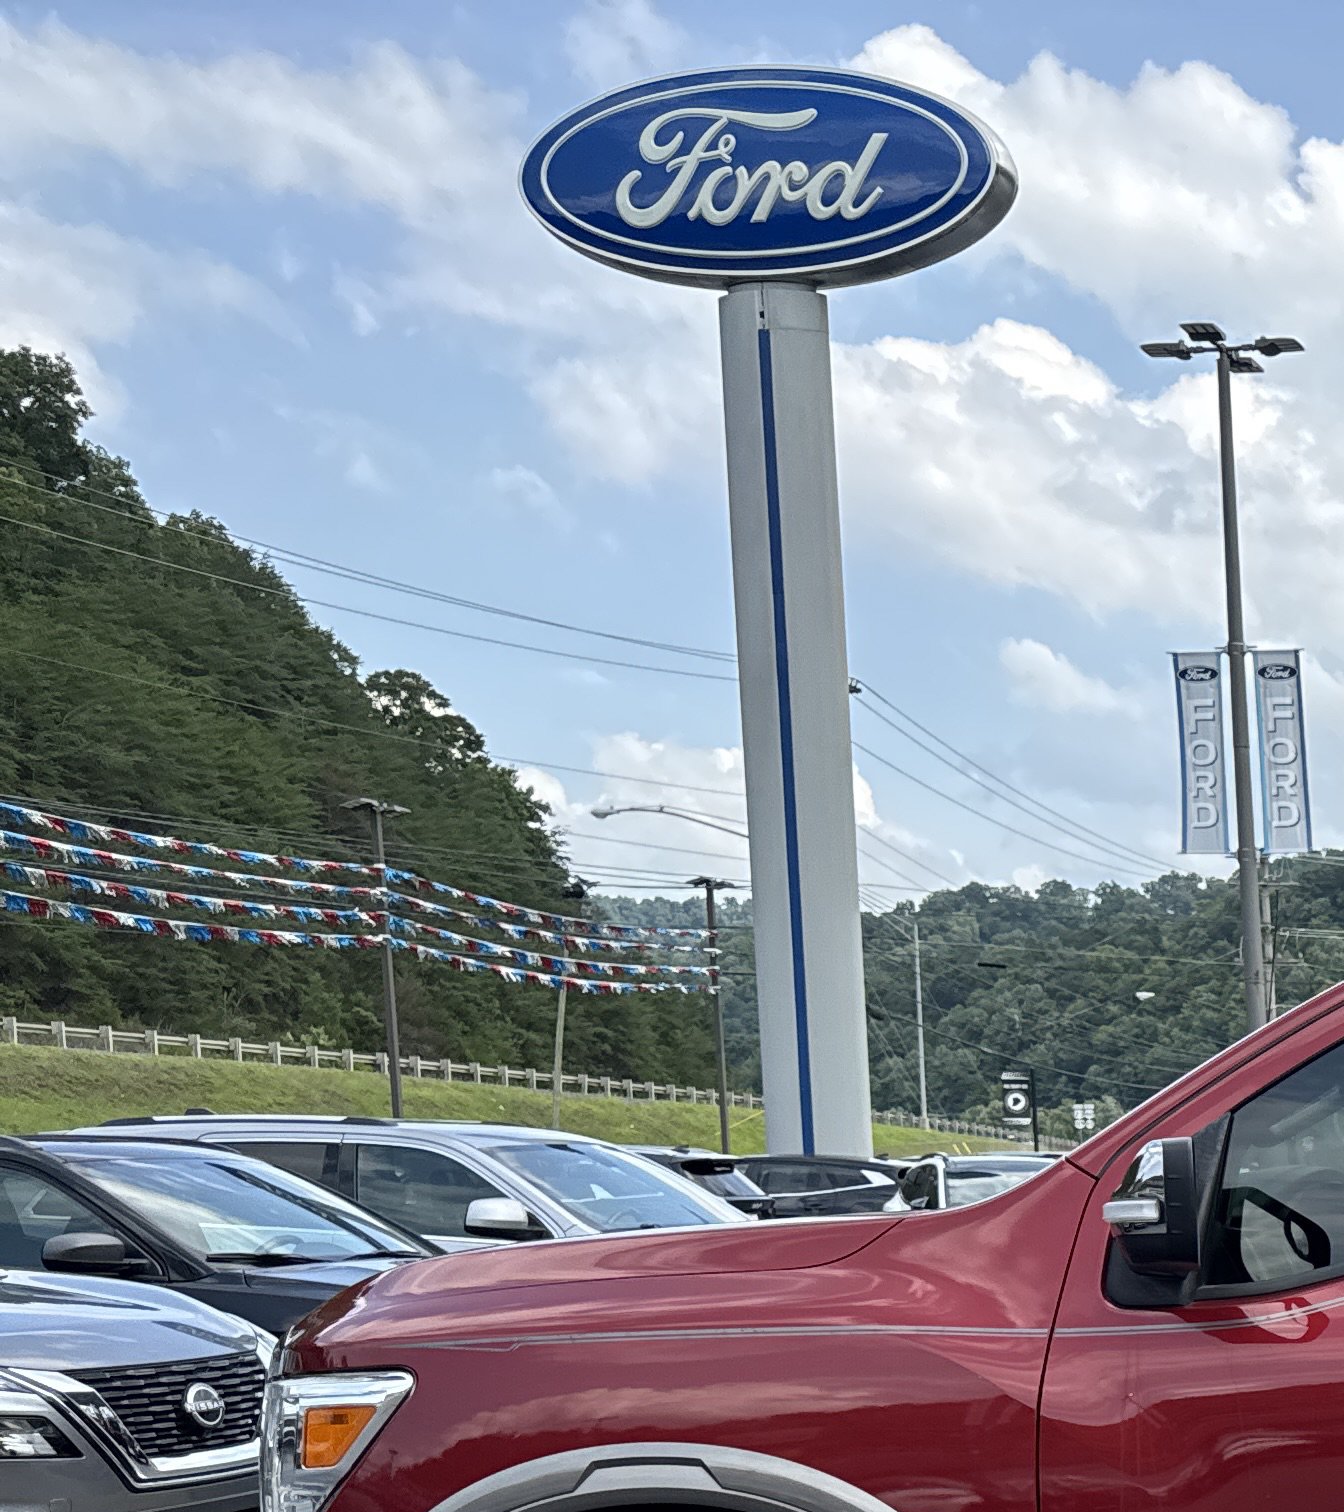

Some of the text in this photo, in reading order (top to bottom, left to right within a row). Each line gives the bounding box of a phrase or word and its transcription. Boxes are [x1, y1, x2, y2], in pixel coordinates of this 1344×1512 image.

[615, 106, 889, 229] Ford
[1184, 667, 1213, 682] Ford
[1263, 664, 1291, 680] Ford
[1187, 697, 1220, 830] FORD
[1263, 695, 1301, 829] FORD
